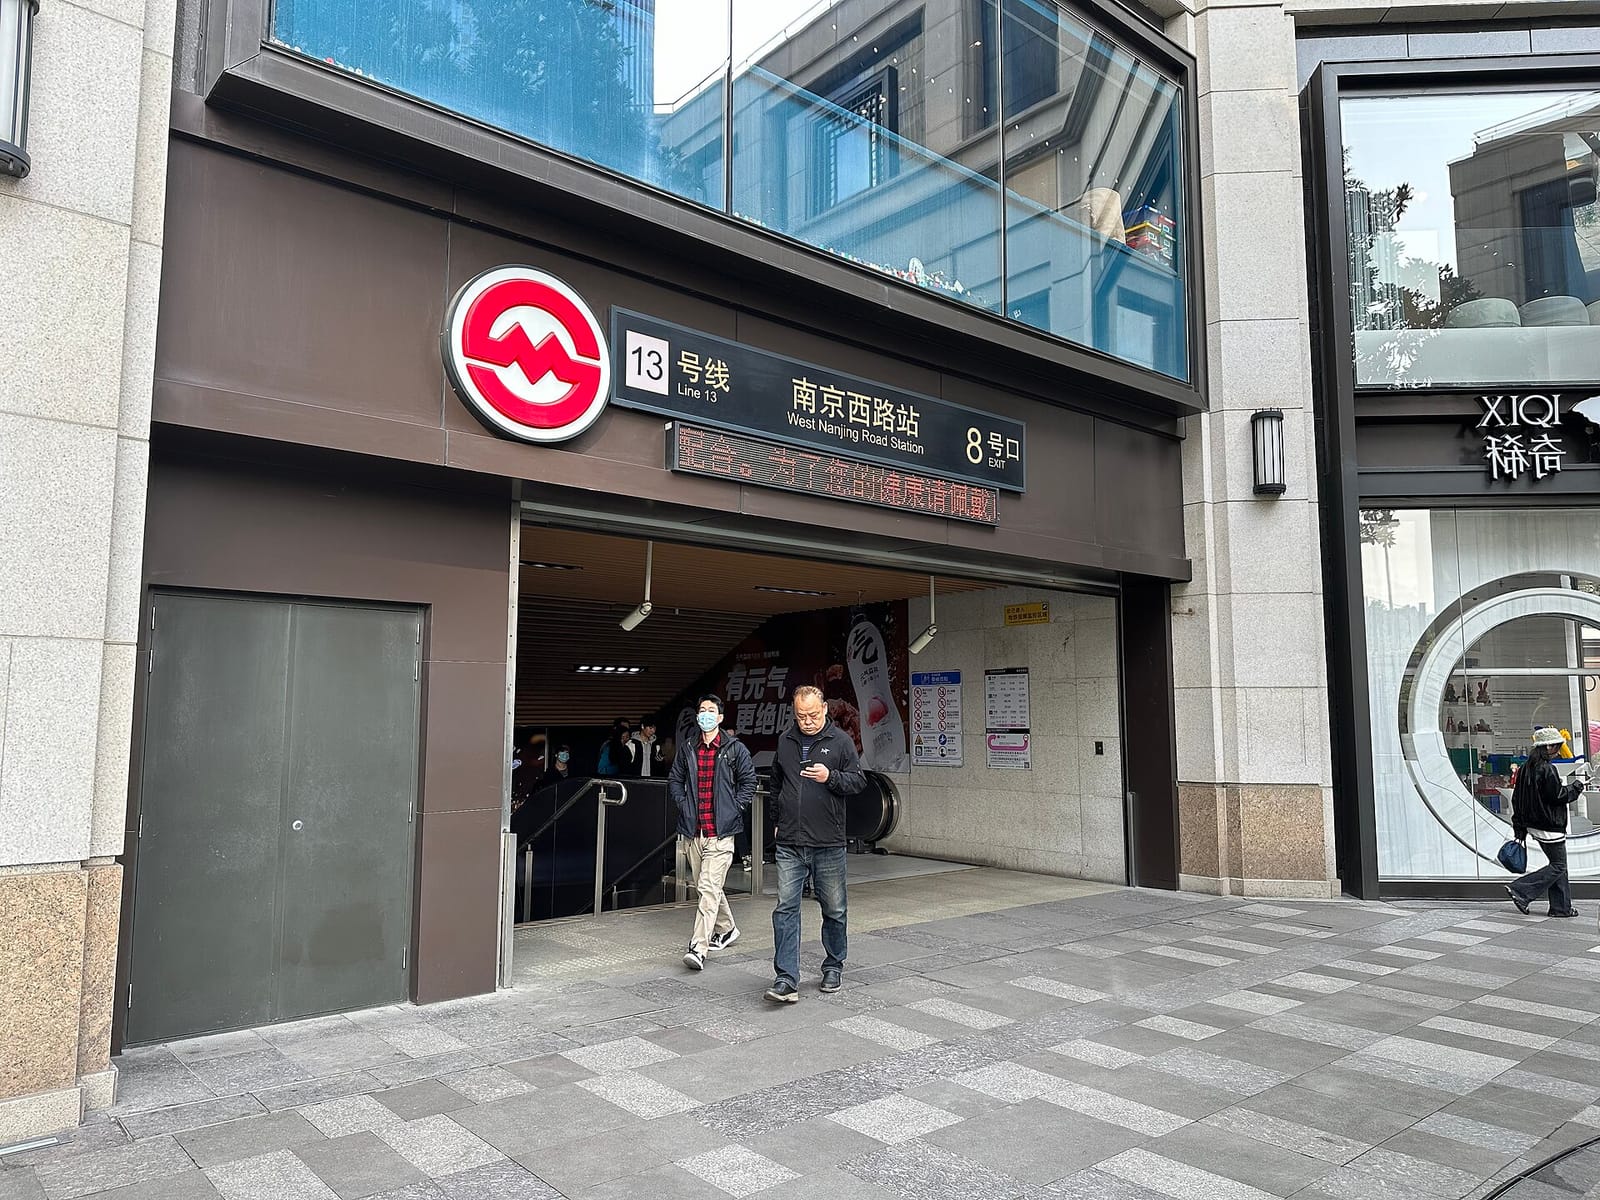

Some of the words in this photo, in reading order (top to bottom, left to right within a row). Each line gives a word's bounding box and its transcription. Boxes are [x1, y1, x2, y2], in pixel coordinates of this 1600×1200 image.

[632, 346, 663, 381] 13
[677, 350, 730, 393] 号线
[677, 382, 701, 399] Line
[704, 389, 718, 403] 13
[792, 376, 920, 438] 南京西路站
[1479, 394, 1562, 428] XIQI
[787, 411, 816, 431] West
[818, 419, 859, 443] Nanjing
[862, 429, 888, 447] Road
[890, 437, 924, 455] Station
[966, 427, 983, 464] 8
[987, 431, 1020, 462] 号口
[988, 457, 1006, 470] EXIT
[1485, 433, 1567, 480] 稀奇
[726, 666, 789, 701] 有元气
